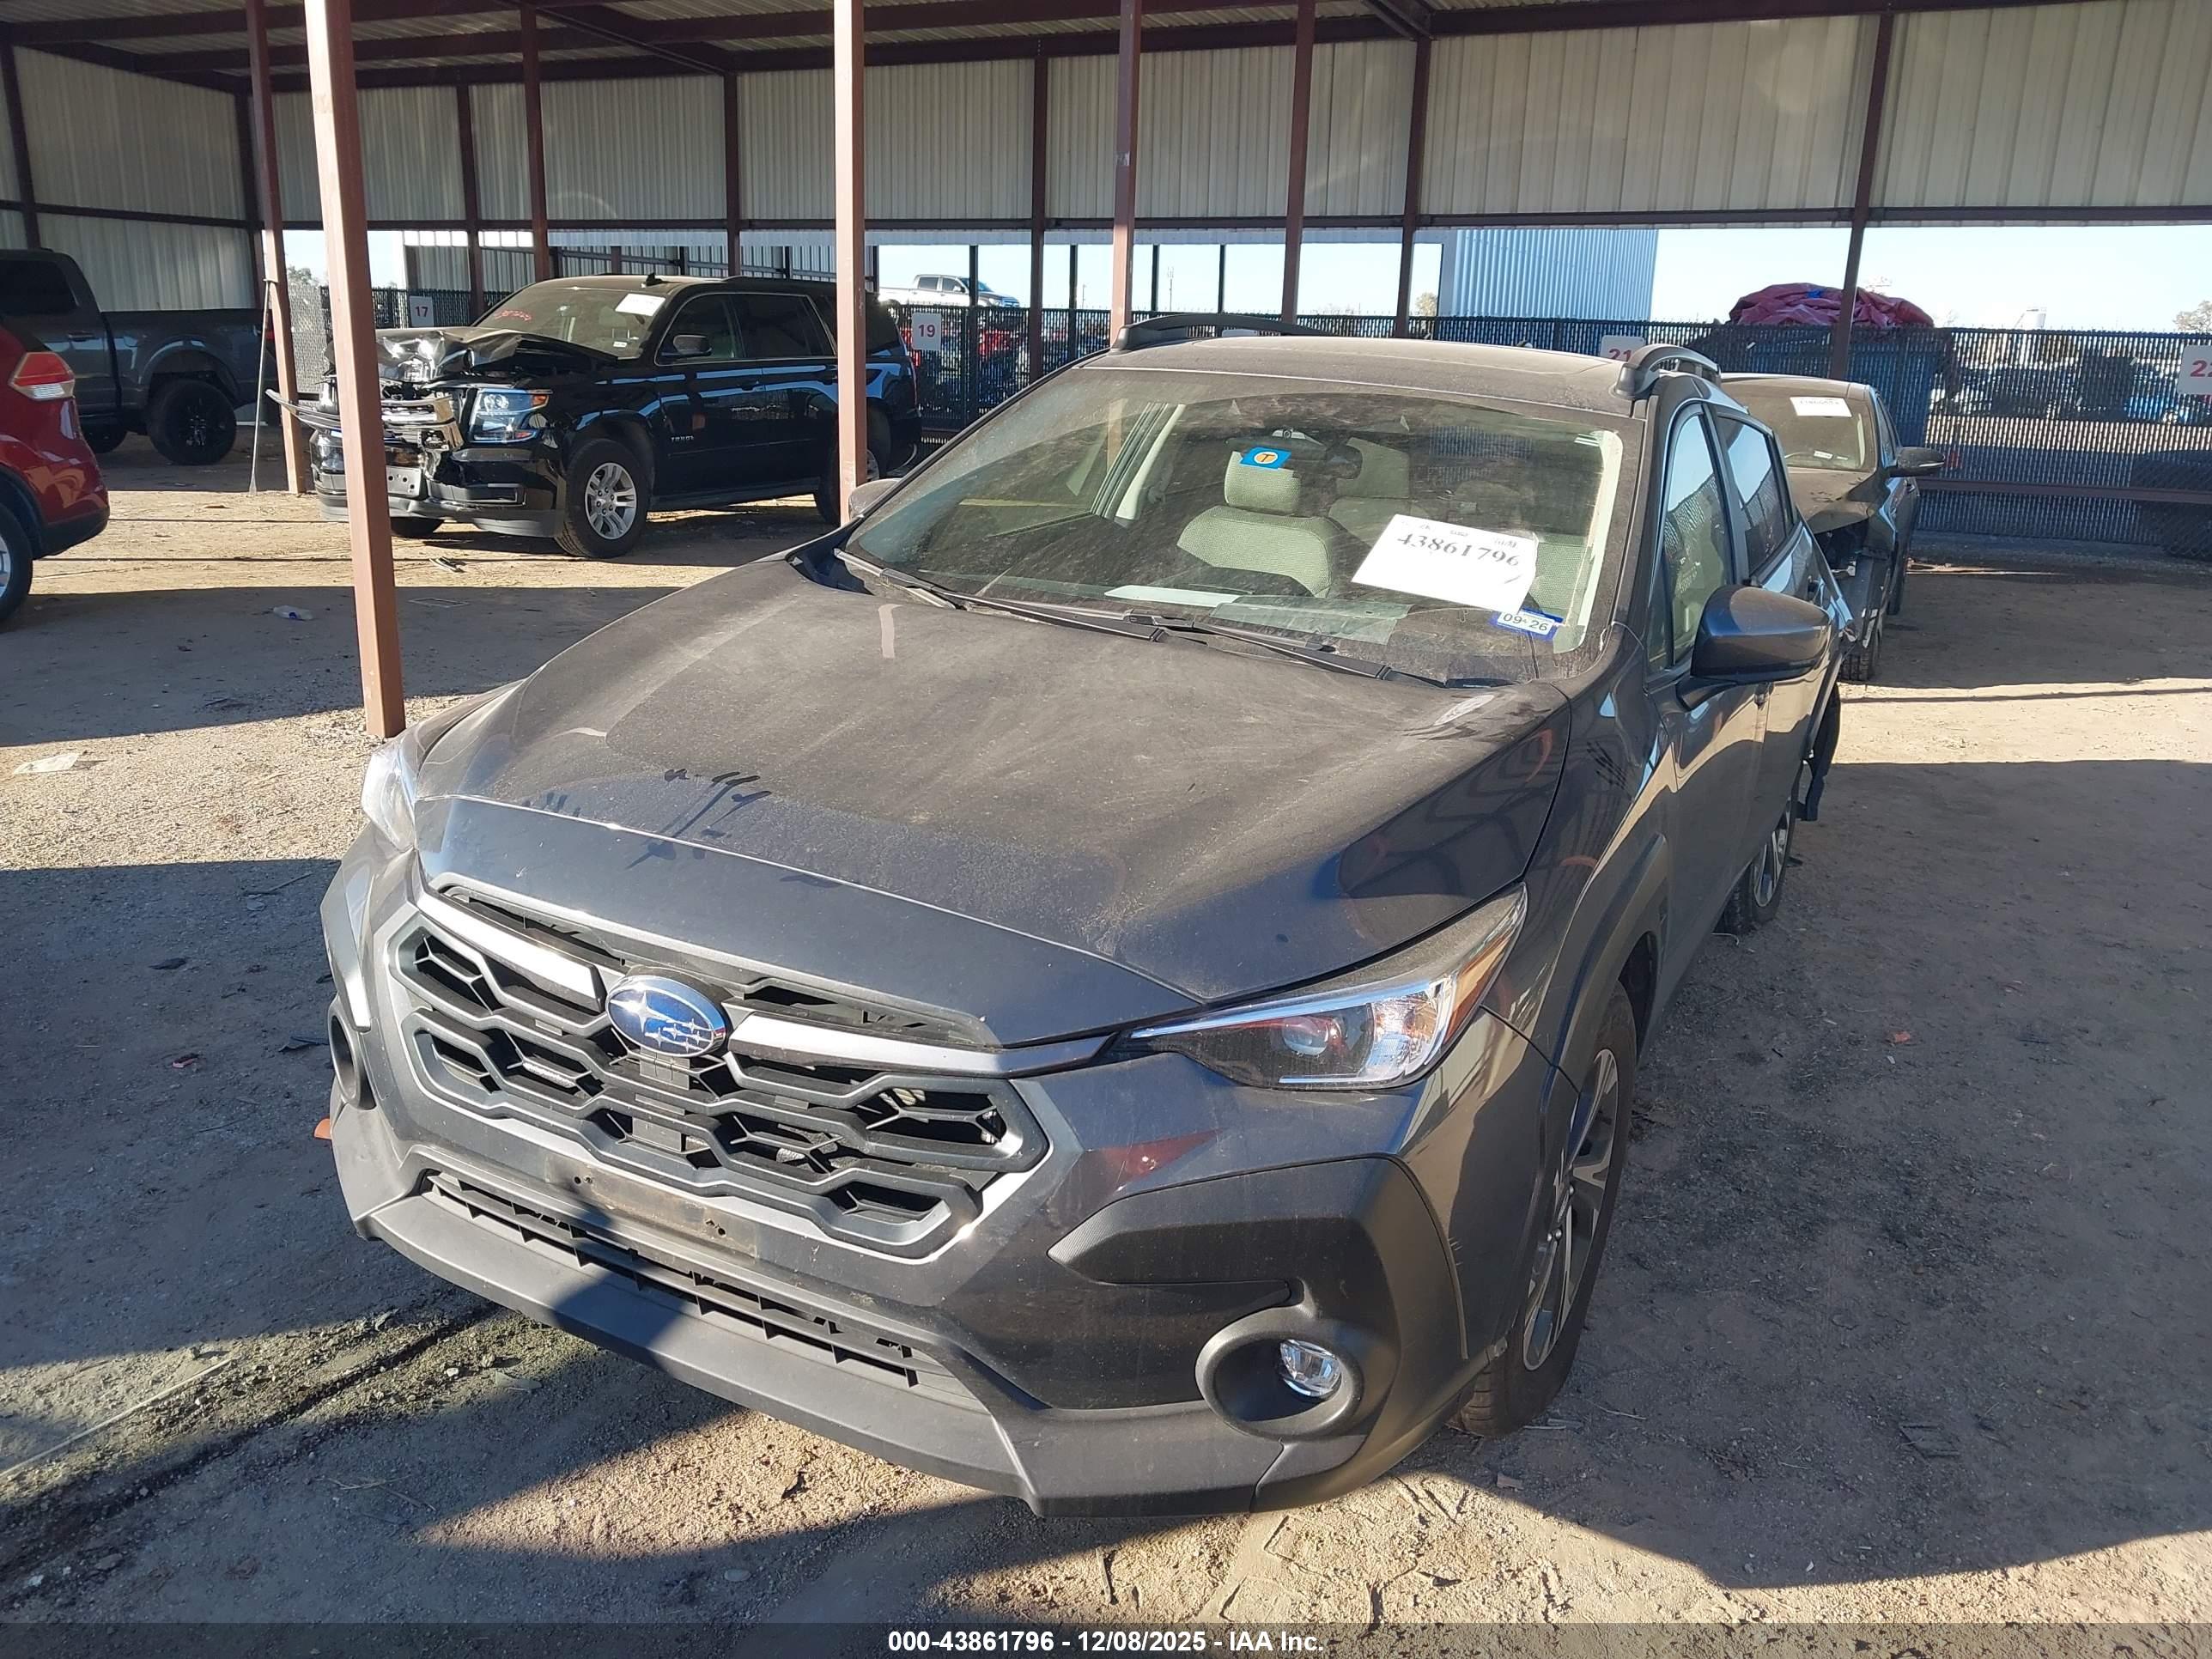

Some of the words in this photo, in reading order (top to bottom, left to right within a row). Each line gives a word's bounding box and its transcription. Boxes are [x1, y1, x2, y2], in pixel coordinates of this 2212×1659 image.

[415, 306, 428, 317] 17
[919, 324, 936, 337] 19
[1608, 348, 1632, 362] 21
[1397, 532, 1520, 567] 43861796
[1503, 613, 1522, 624] 09
[1528, 620, 1549, 631] 26
